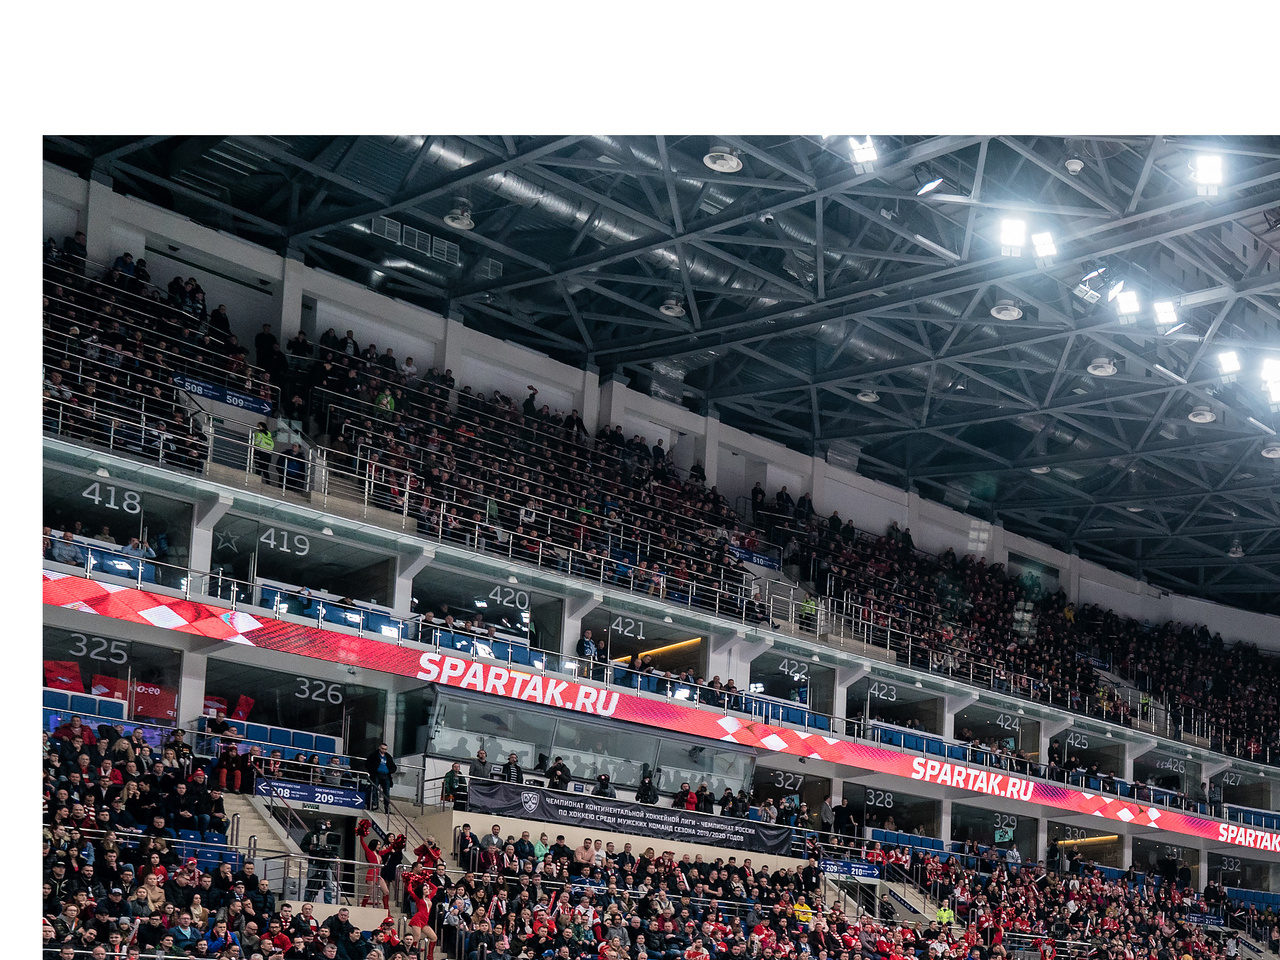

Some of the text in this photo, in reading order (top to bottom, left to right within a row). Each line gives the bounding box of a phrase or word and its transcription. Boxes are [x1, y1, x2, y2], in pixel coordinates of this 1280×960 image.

[184, 382, 204, 395] 508
[226, 395, 245, 408] 509
[82, 481, 141, 515] 418
[259, 527, 310, 556] 419
[488, 585, 530, 611] 420
[611, 616, 646, 641] 421
[68, 632, 129, 666] 325
[778, 658, 809, 678] 422
[294, 677, 344, 706] 326
[415, 651, 621, 717] SPARTAK.RU
[869, 681, 898, 702] 423
[995, 713, 1020, 732] 424
[1066, 732, 1089, 749] 425
[1166, 758, 1186, 774] 426
[774, 770, 805, 792] 327
[911, 757, 1035, 801] SPARTAK.RU
[1222, 772, 1242, 787] 427
[315, 793, 334, 804] 209
[866, 789, 894, 809] 328
[545, 797, 585, 809] ЧЕМПИОНАТ
[585, 803, 645, 818] КОНТИНЕНТАЛЬНОЙ
[645, 812, 680, 824] ХОККЕЙНОЙ
[680, 817, 696, 826] ЛИГИ
[700, 821, 734, 832] ЧЕМПИОНАТ
[735, 826, 756, 835] РОССИИ
[558, 809, 744, 842] ПО ХОККЕЮ СРЕДИ МУЖСКИХ КОМАНД СЕЗОНА 2019/2020 ГОДОВ
[993, 813, 1018, 831] 329
[1065, 826, 1087, 843] 330
[826, 864, 838, 873] 209
[851, 867, 863, 876] 210
[1221, 857, 1242, 872] 332
